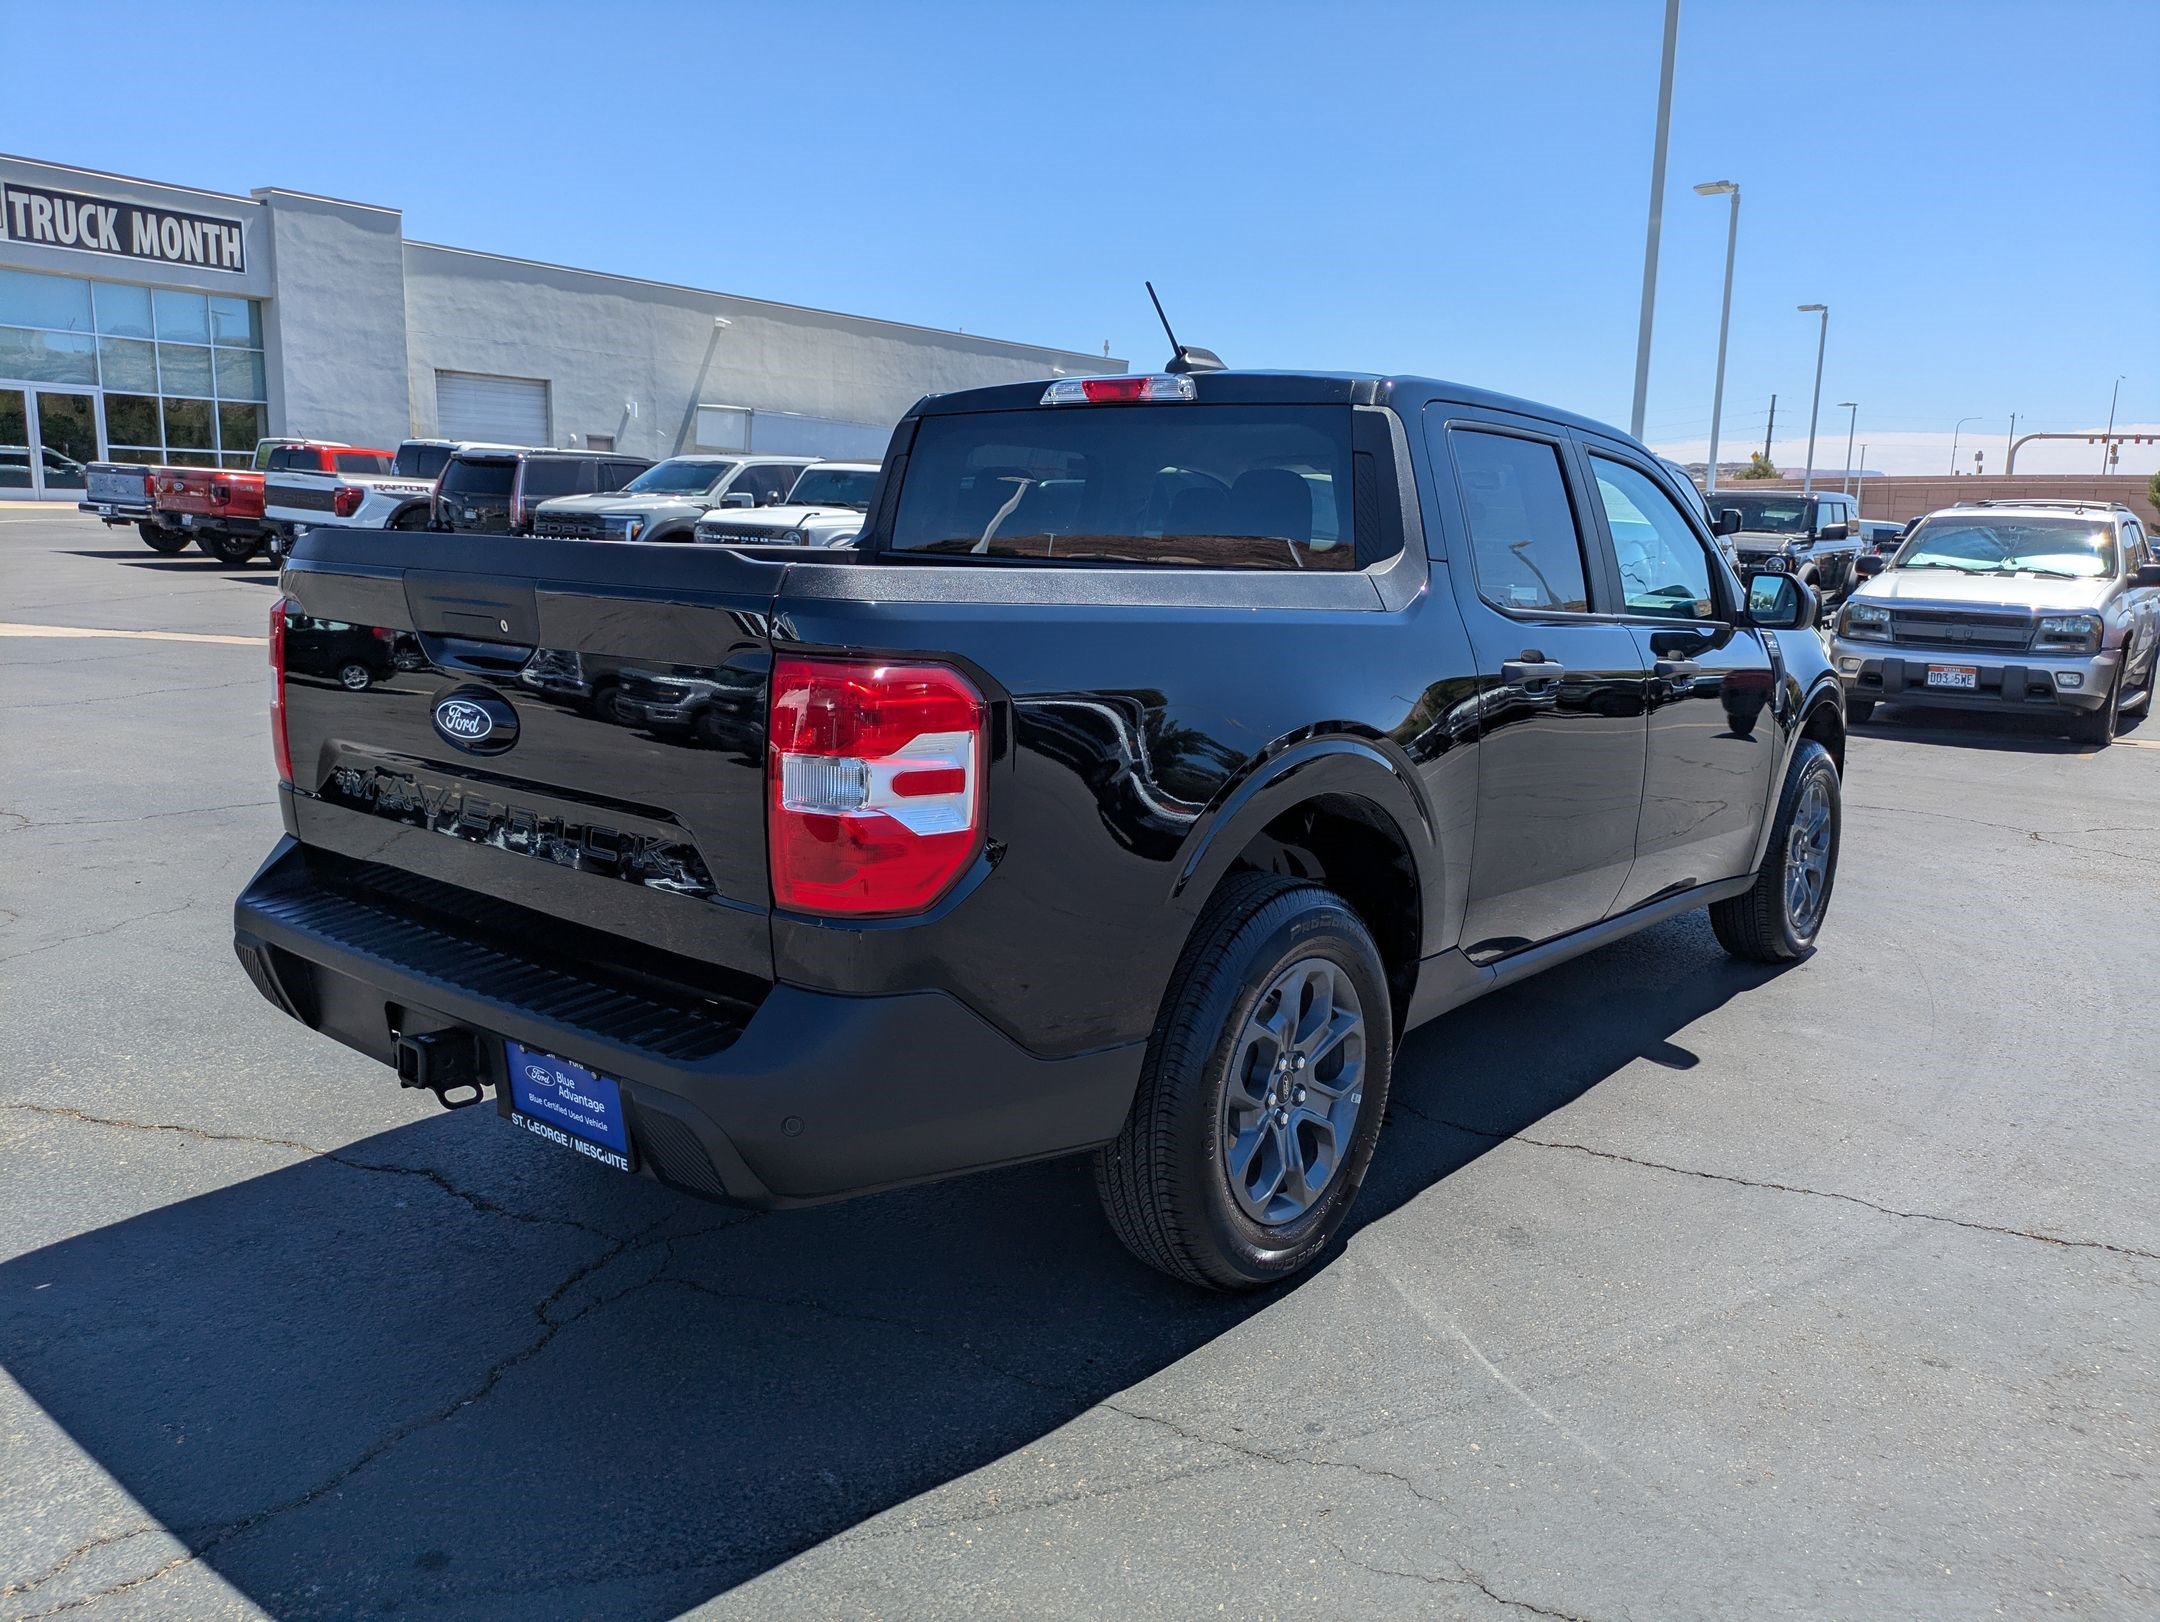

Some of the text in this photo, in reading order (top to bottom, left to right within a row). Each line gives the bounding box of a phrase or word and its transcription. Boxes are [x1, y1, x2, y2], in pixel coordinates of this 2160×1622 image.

[8, 190, 242, 269] TRUCK MONTH
[373, 483, 430, 494] RAPTOR
[444, 702, 482, 736] Ford
[530, 1066, 551, 1086] Ford
[555, 1071, 576, 1090] Blue
[528, 1093, 609, 1132] Blue Certified Used Vehicle
[558, 1085, 605, 1113] Advantage
[511, 1112, 526, 1129] ST.
[527, 1119, 568, 1148] GEORGE
[575, 1138, 629, 1172] MESQUITE
